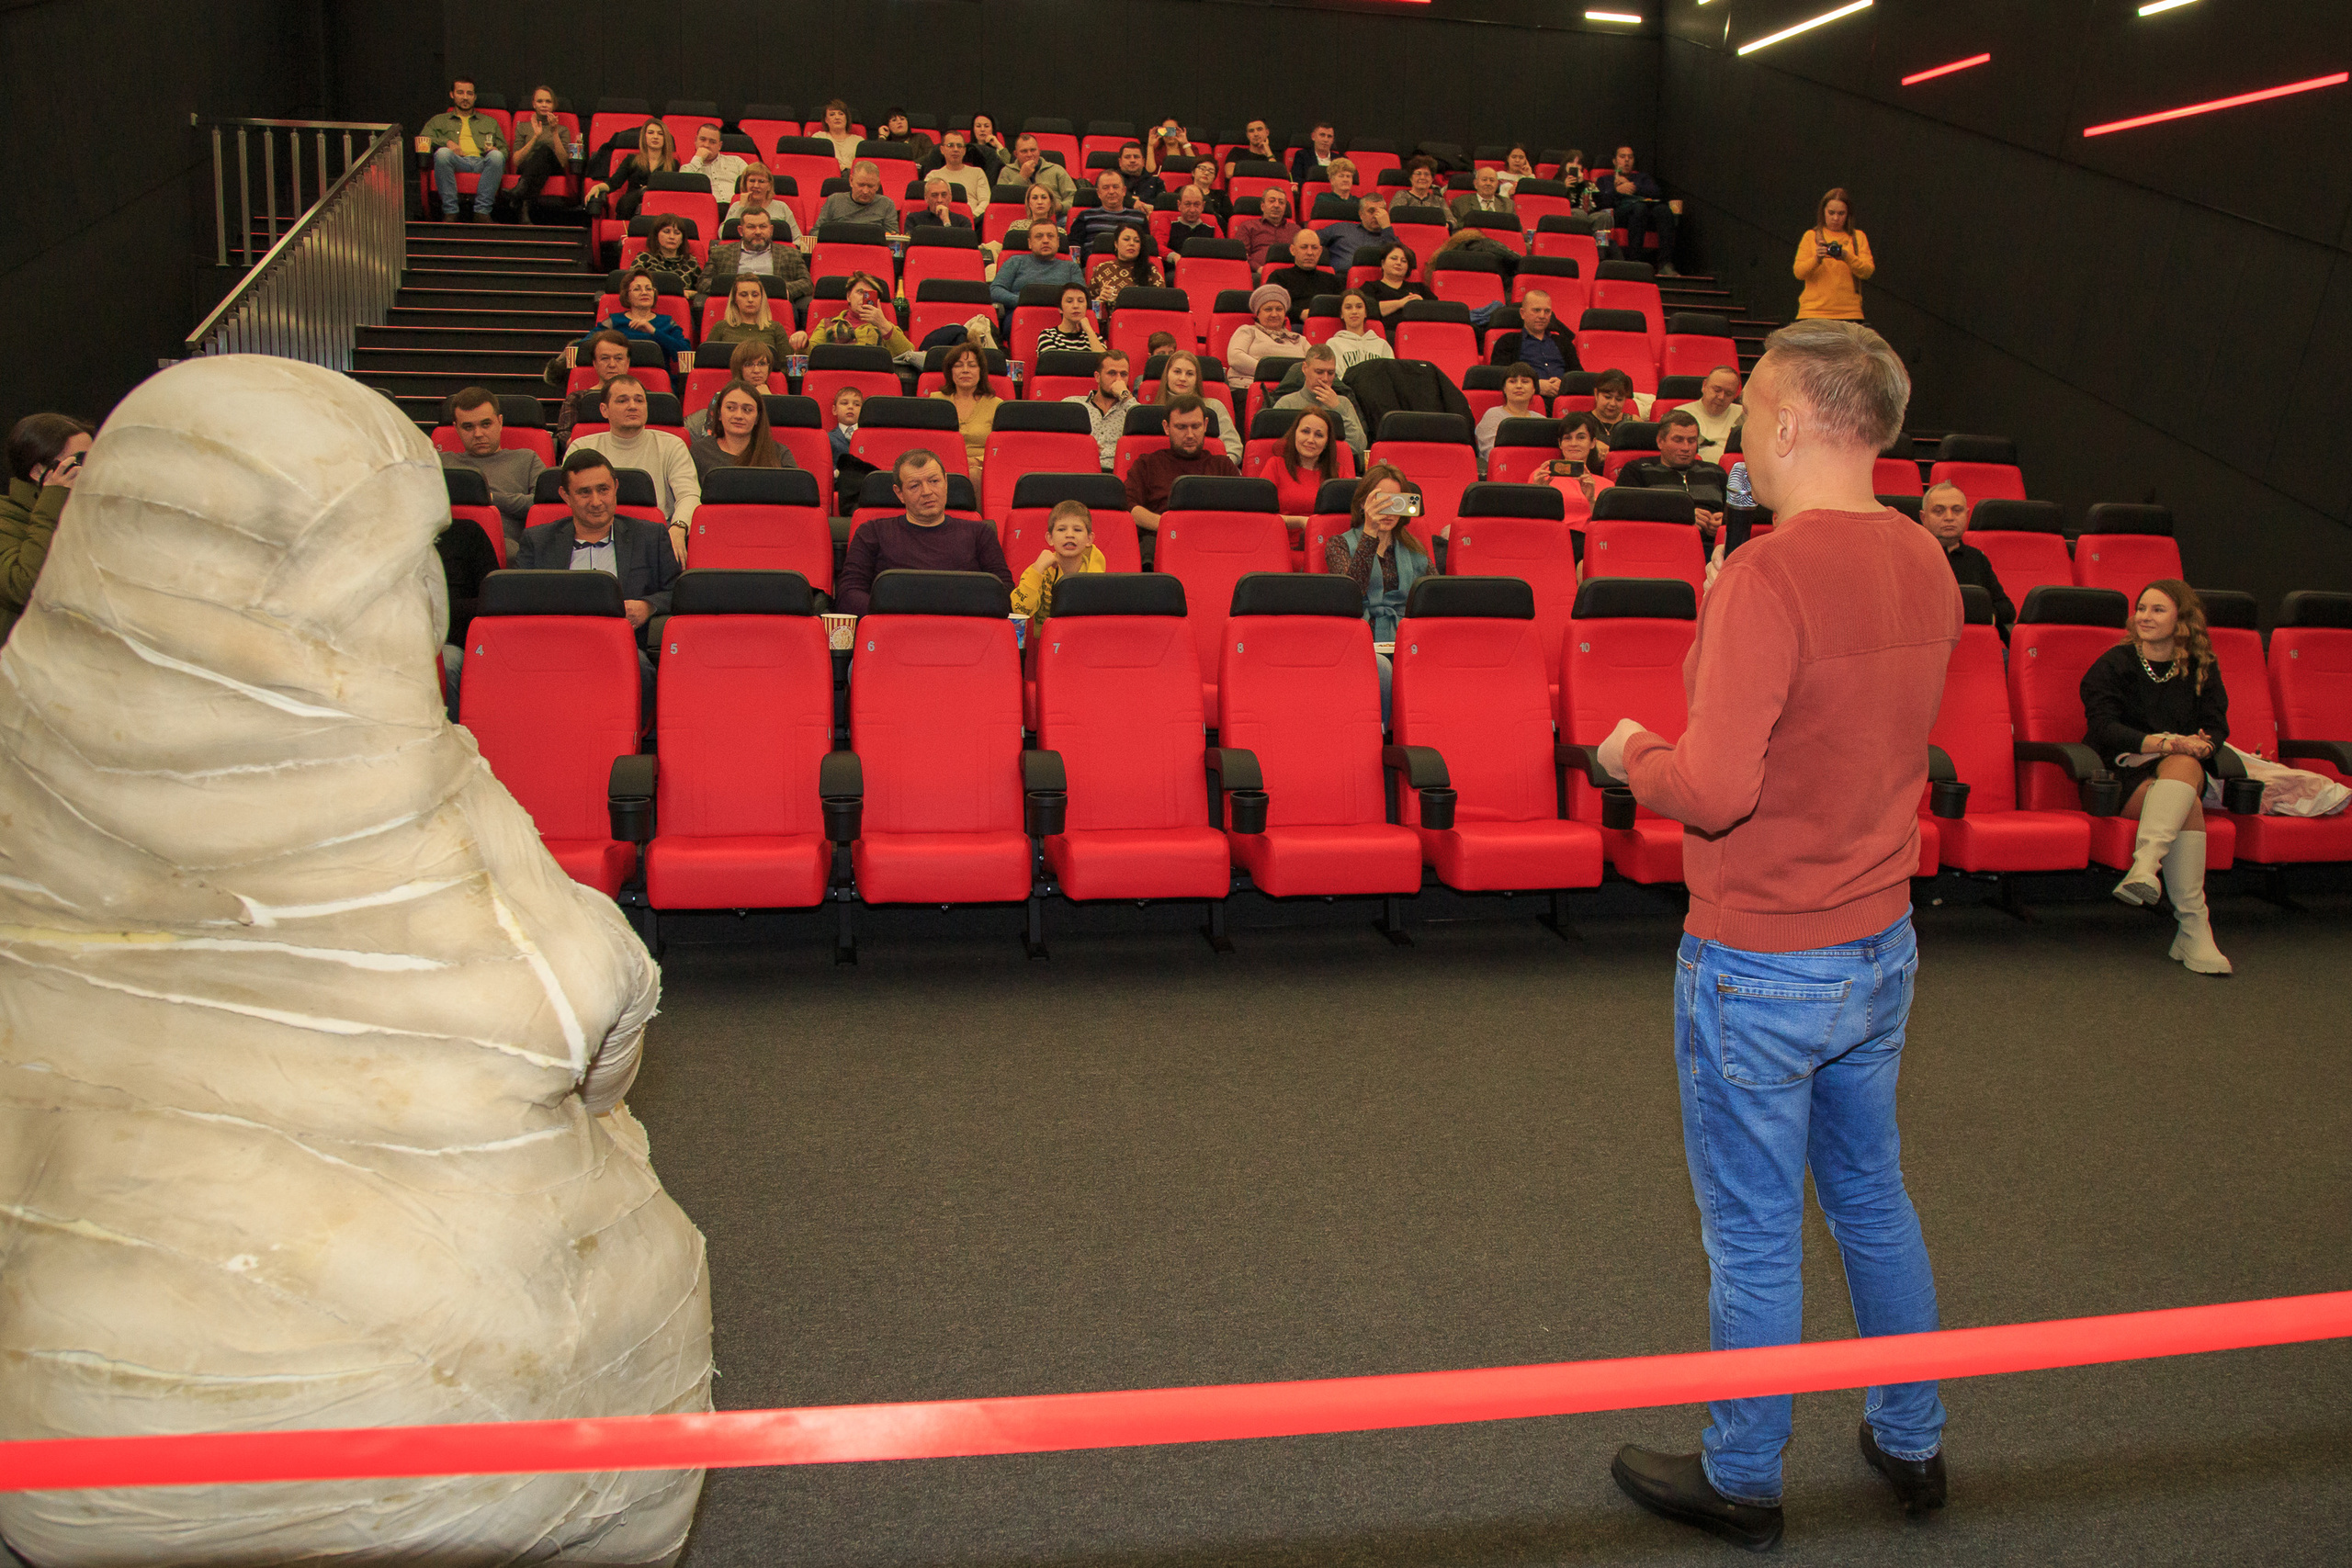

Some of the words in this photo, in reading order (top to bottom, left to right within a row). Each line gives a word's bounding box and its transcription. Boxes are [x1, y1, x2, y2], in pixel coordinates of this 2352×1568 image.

[573, 381, 579, 389] 1
[692, 382, 698, 391] 2
[808, 383, 814, 392] 3
[922, 388, 929, 396] 4
[1035, 389, 1042, 398] 5
[1145, 394, 1151, 402] 6
[1255, 395, 1261, 404] 7
[857, 446, 865, 455] 6
[991, 446, 999, 457] 7
[1125, 452, 1131, 461] 8
[1253, 456, 1261, 465] 9
[1498, 463, 1507, 472] 11
[698, 525, 706, 536] 5
[1013, 528, 1022, 539] 7
[1170, 530, 1177, 540] 8
[1317, 535, 1324, 545] 9
[1461, 536, 1472, 547] 10
[1599, 540, 1608, 550] 11
[474, 644, 485, 657] 4
[670, 642, 678, 655] 5
[866, 640, 876, 652] 6
[1052, 642, 1061, 654] 7
[1237, 642, 1245, 654] 8
[1410, 644, 1419, 655] 9
[1578, 642, 1590, 653] 10
